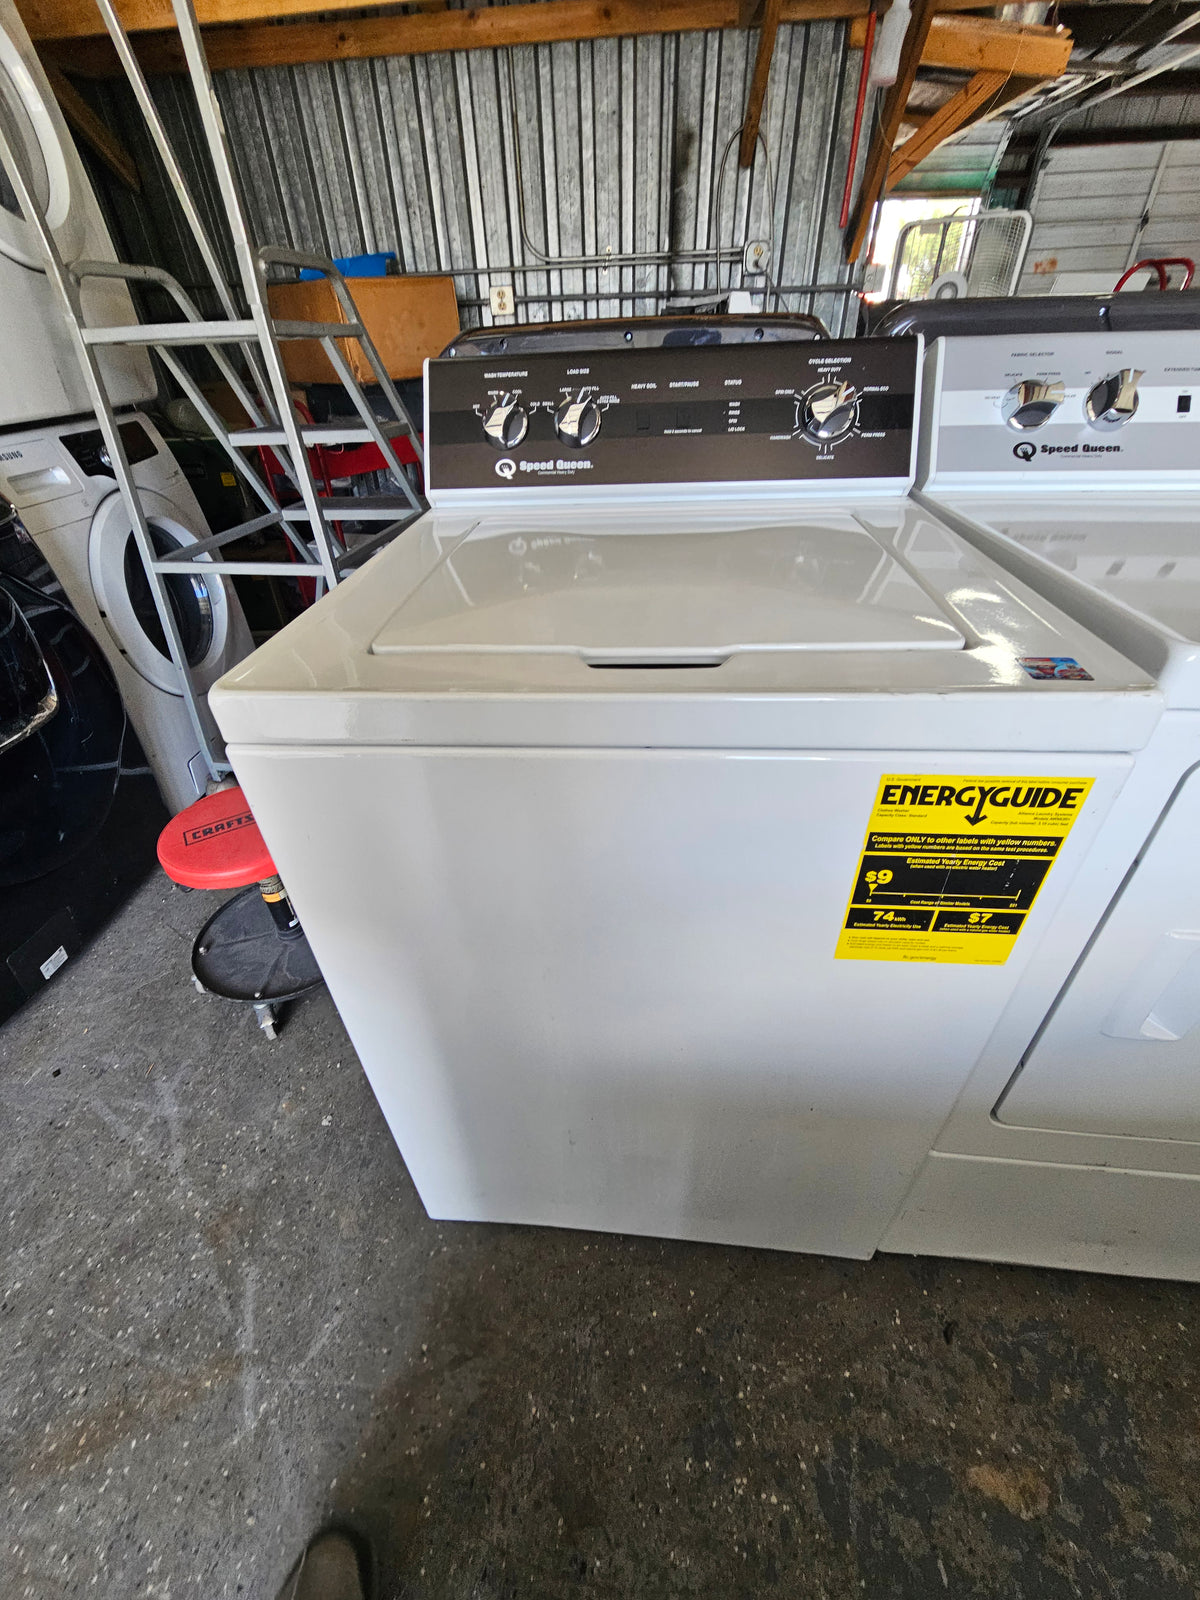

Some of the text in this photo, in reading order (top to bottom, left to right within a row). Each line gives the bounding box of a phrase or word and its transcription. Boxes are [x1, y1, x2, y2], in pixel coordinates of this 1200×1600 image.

[668, 380, 699, 388] START/PAUSE
[1040, 444, 1078, 455] Speed
[520, 460, 554, 472] Speed
[880, 785, 1085, 810] ENERGYGUIDE
[192, 813, 256, 840] CRAFTS
[872, 835, 904, 843] Compare
[927, 836, 935, 844] to
[996, 838, 1021, 846] yellow
[941, 858, 962, 866] Yearly
[963, 859, 988, 867] Energy
[864, 869, 894, 884] $9
[873, 910, 895, 922] 74
[968, 912, 993, 924] $7
